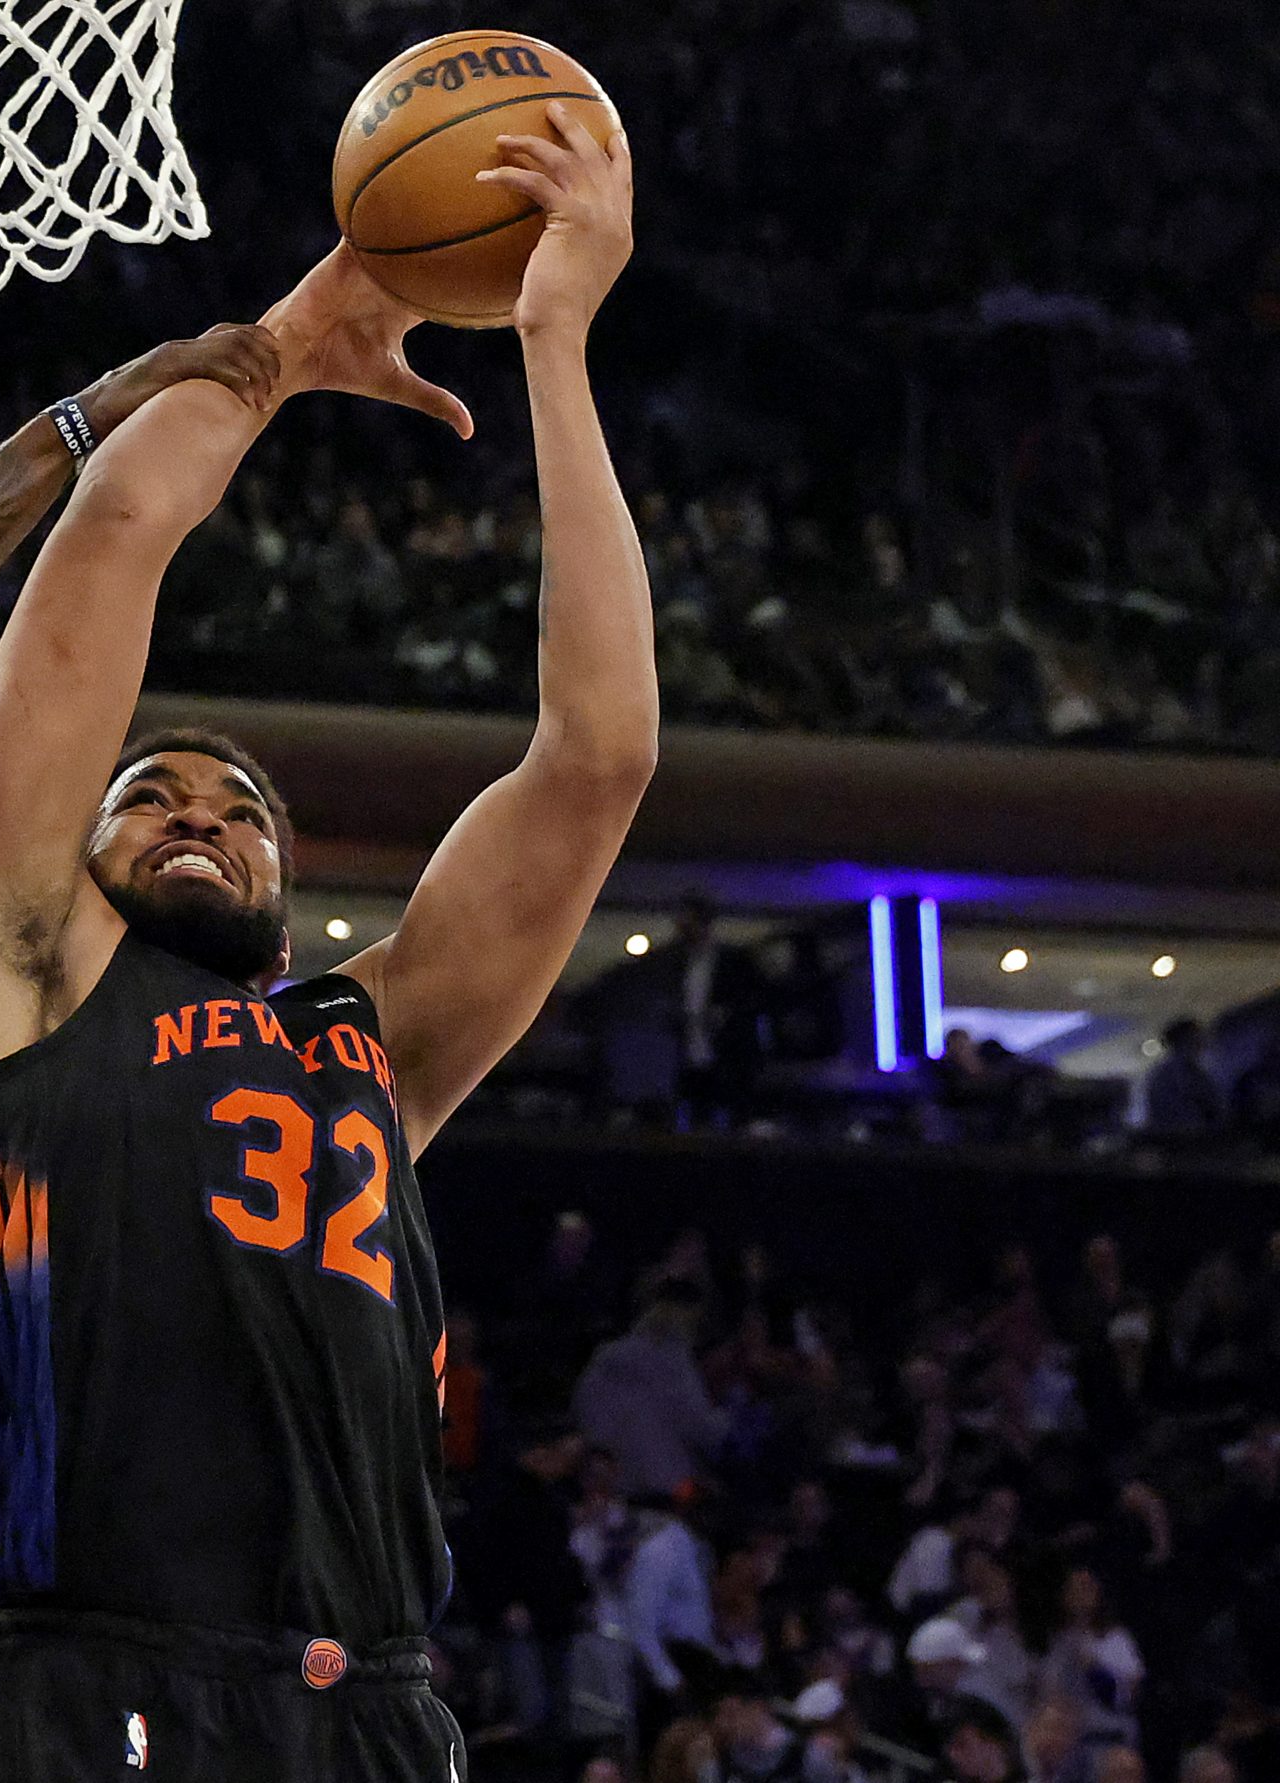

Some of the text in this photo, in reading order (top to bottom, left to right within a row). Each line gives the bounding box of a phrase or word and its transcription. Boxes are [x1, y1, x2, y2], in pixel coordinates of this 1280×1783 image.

[361, 46, 551, 137] Wilson
[55, 415, 82, 456] READY
[67, 403, 94, 449] D'EVILS
[209, 1085, 395, 1304] 32
